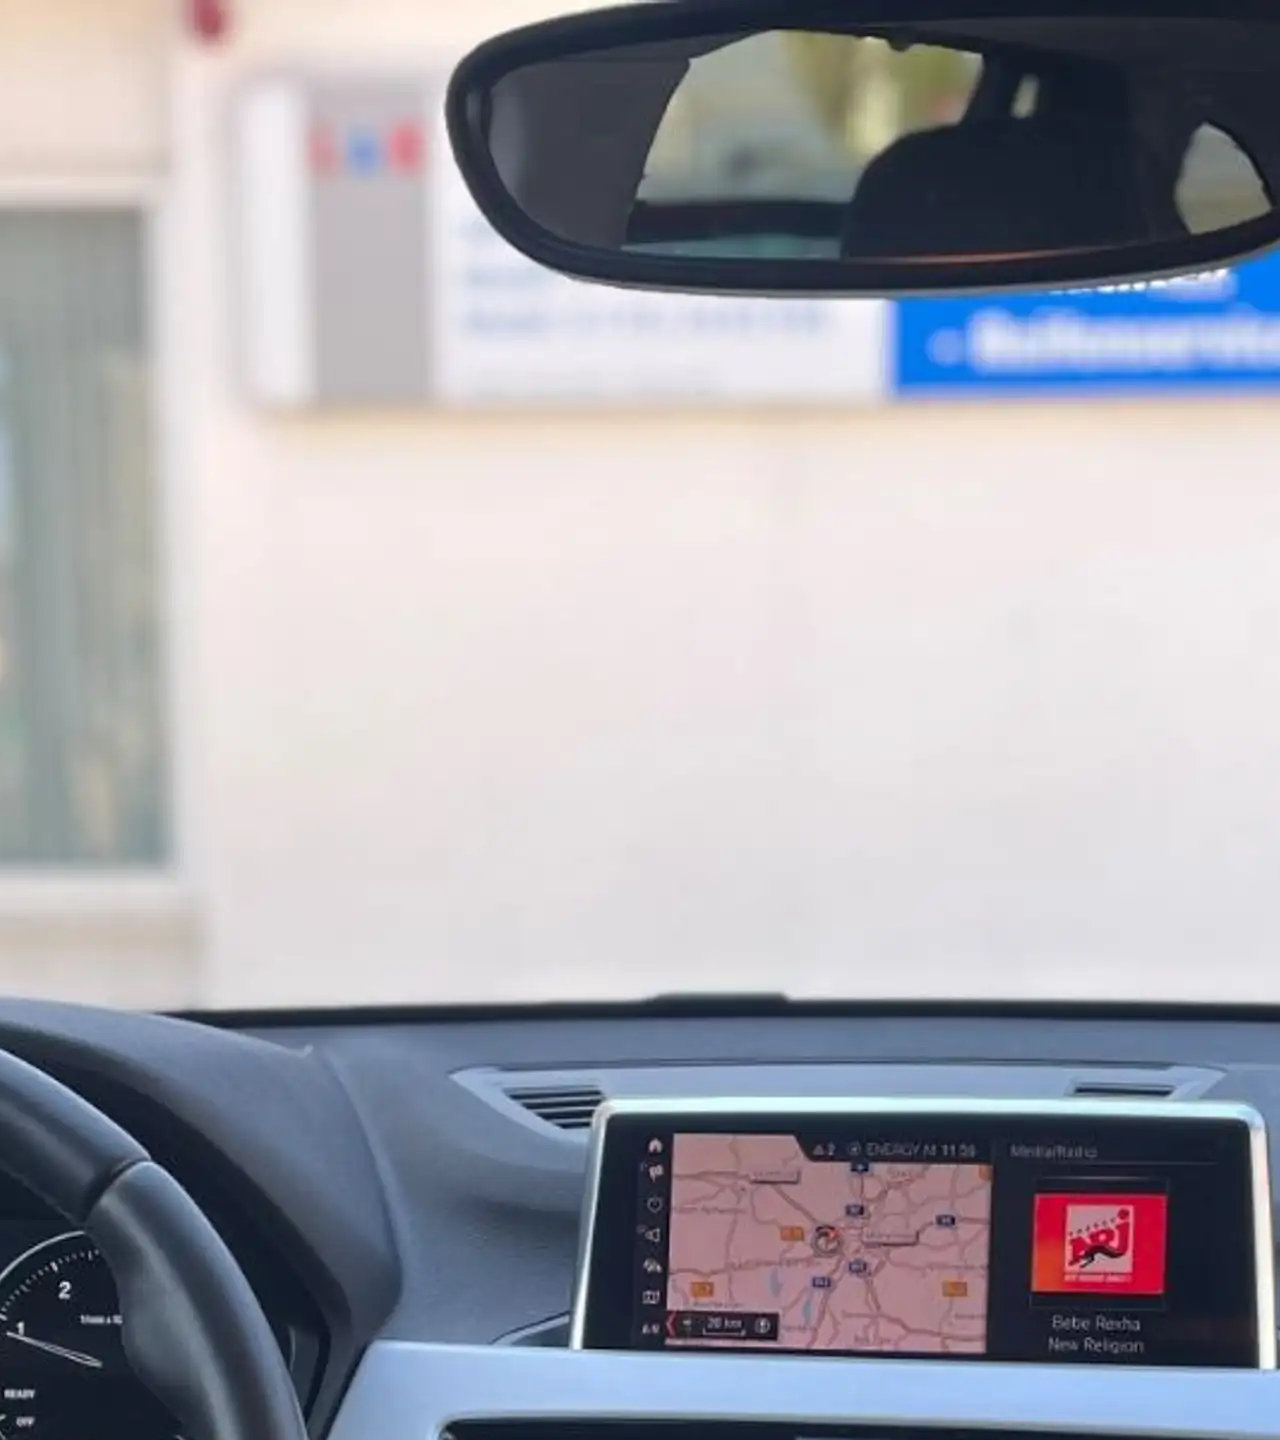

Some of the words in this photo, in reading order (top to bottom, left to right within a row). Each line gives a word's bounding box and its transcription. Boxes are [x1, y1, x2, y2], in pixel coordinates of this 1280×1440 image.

[58, 1281, 72, 1299] 2
[17, 1321, 25, 1336] 1
[1052, 1315, 1090, 1331] Bebe
[1096, 1315, 1141, 1332] Rexha
[1048, 1337, 1078, 1351] New
[1084, 1337, 1144, 1354] Religion
